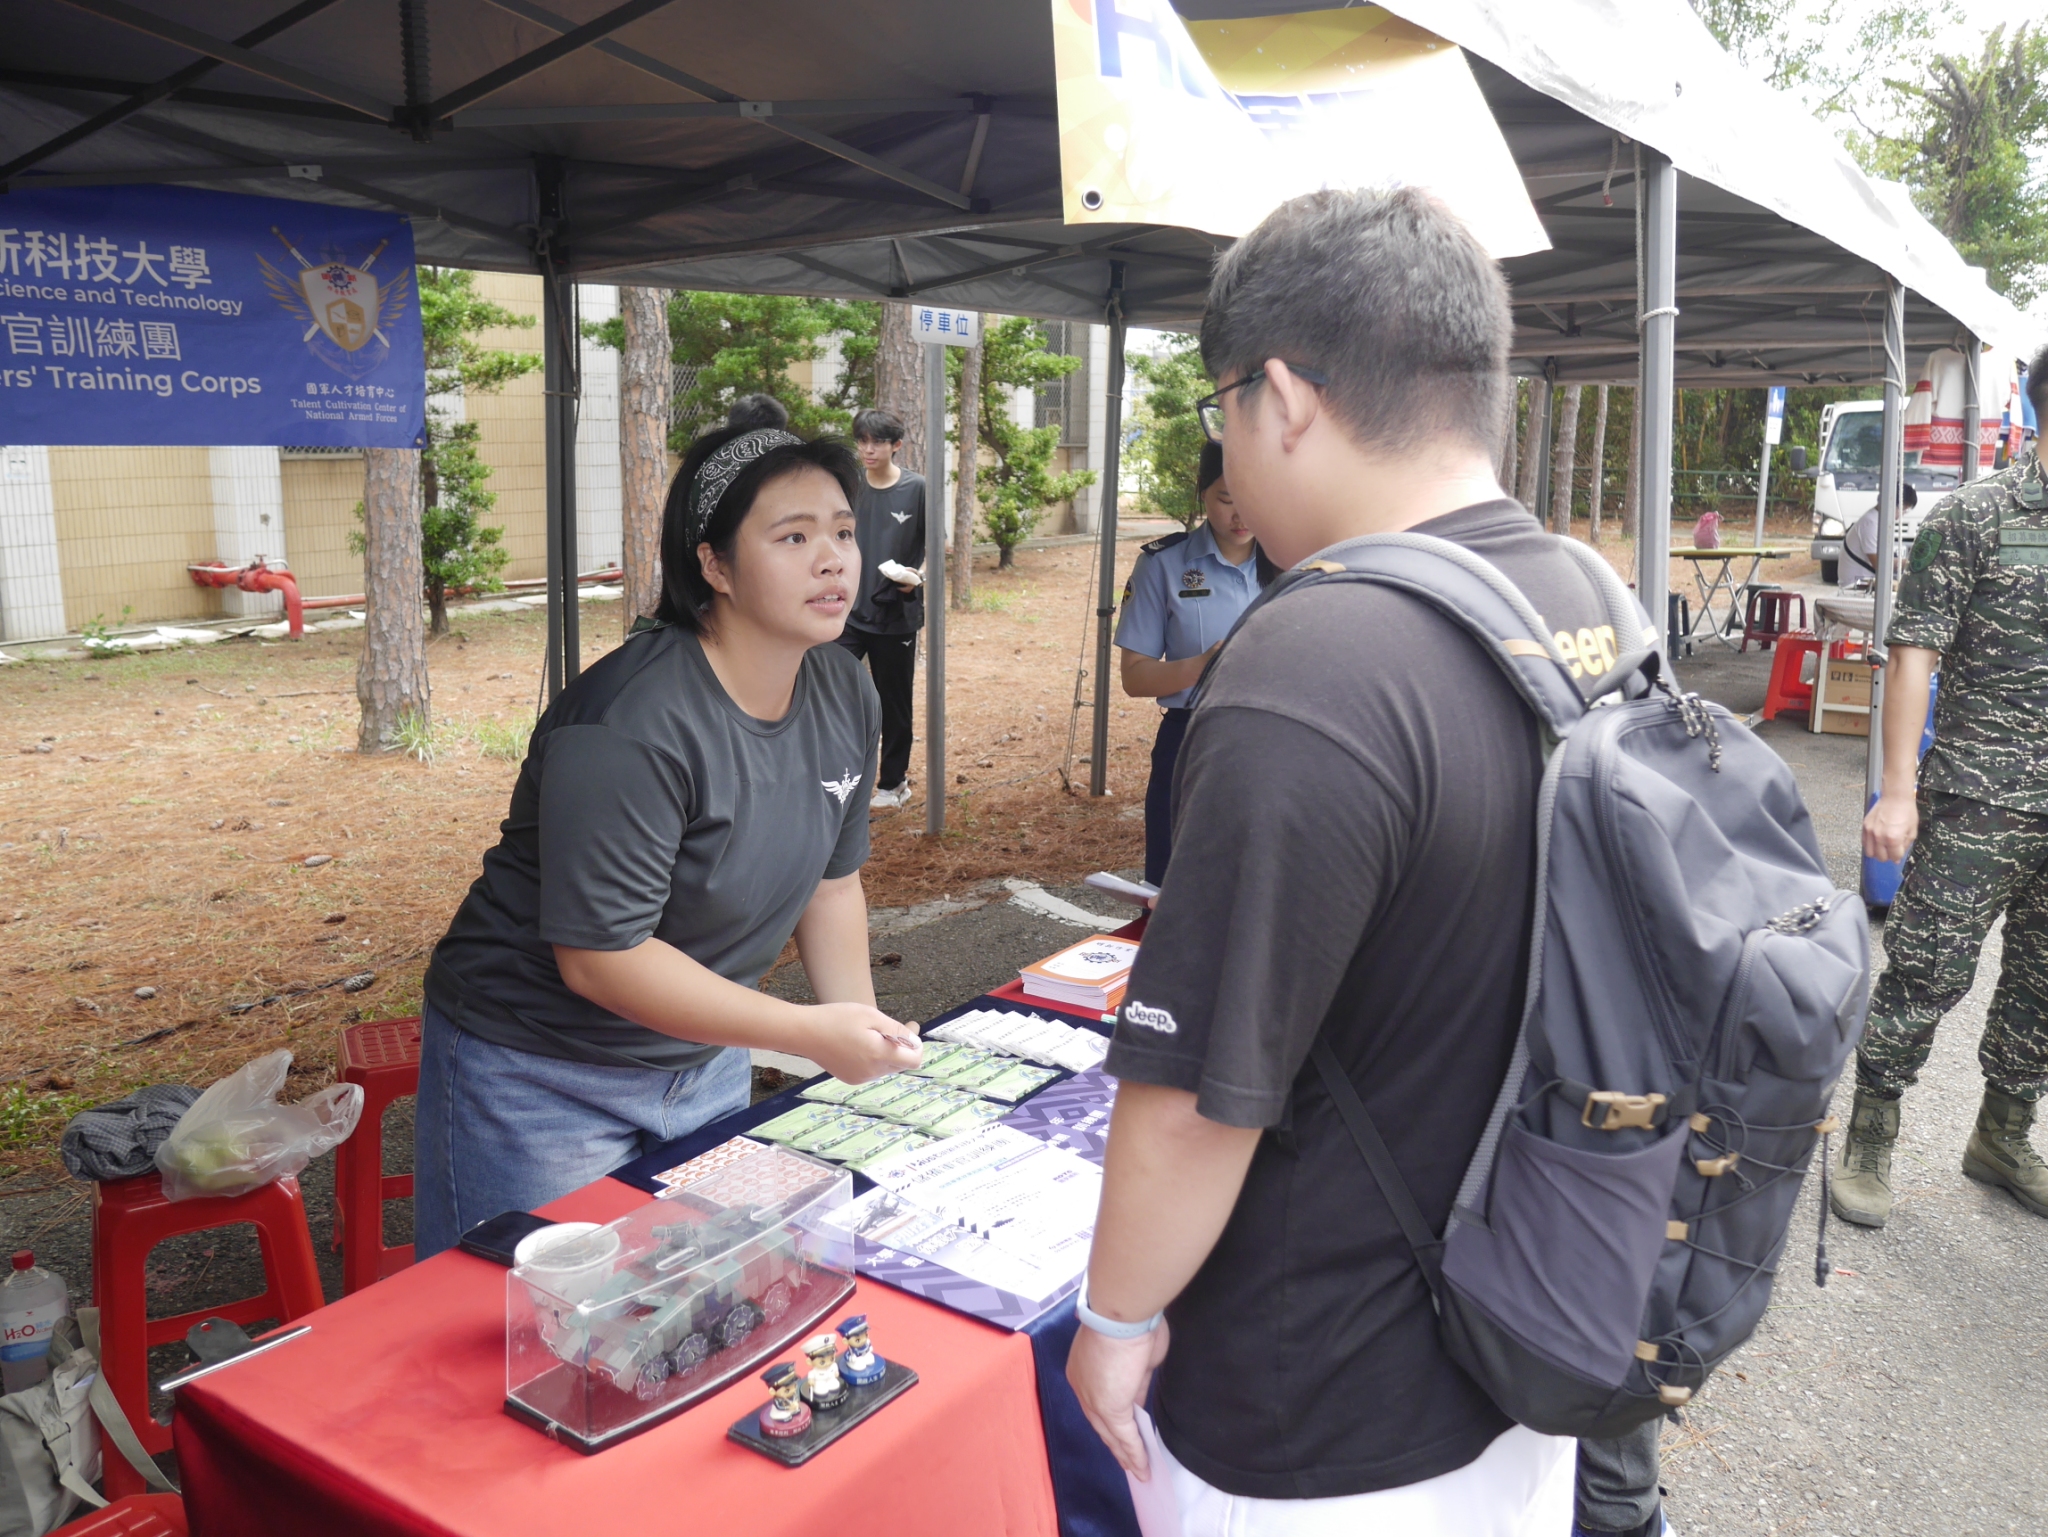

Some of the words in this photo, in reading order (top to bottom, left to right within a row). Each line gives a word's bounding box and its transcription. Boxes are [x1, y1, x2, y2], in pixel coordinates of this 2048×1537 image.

[74, 288, 116, 306] and
[120, 288, 243, 316] Technology
[919, 308, 969, 336] 停車位
[0, 312, 182, 361] 官訓練團
[0, 365, 37, 388] rs'
[45, 366, 174, 397] Training
[181, 370, 262, 399] Corps
[306, 382, 395, 398] 國軍人才培育中心
[290, 399, 321, 409] Talent
[325, 400, 371, 411] Cultivation
[374, 402, 396, 413] Center
[399, 404, 407, 413] of
[305, 410, 344, 420] National
[348, 412, 373, 422] Armed
[376, 413, 398, 423] Forces
[1127, 1003, 1171, 1030] Jeep
